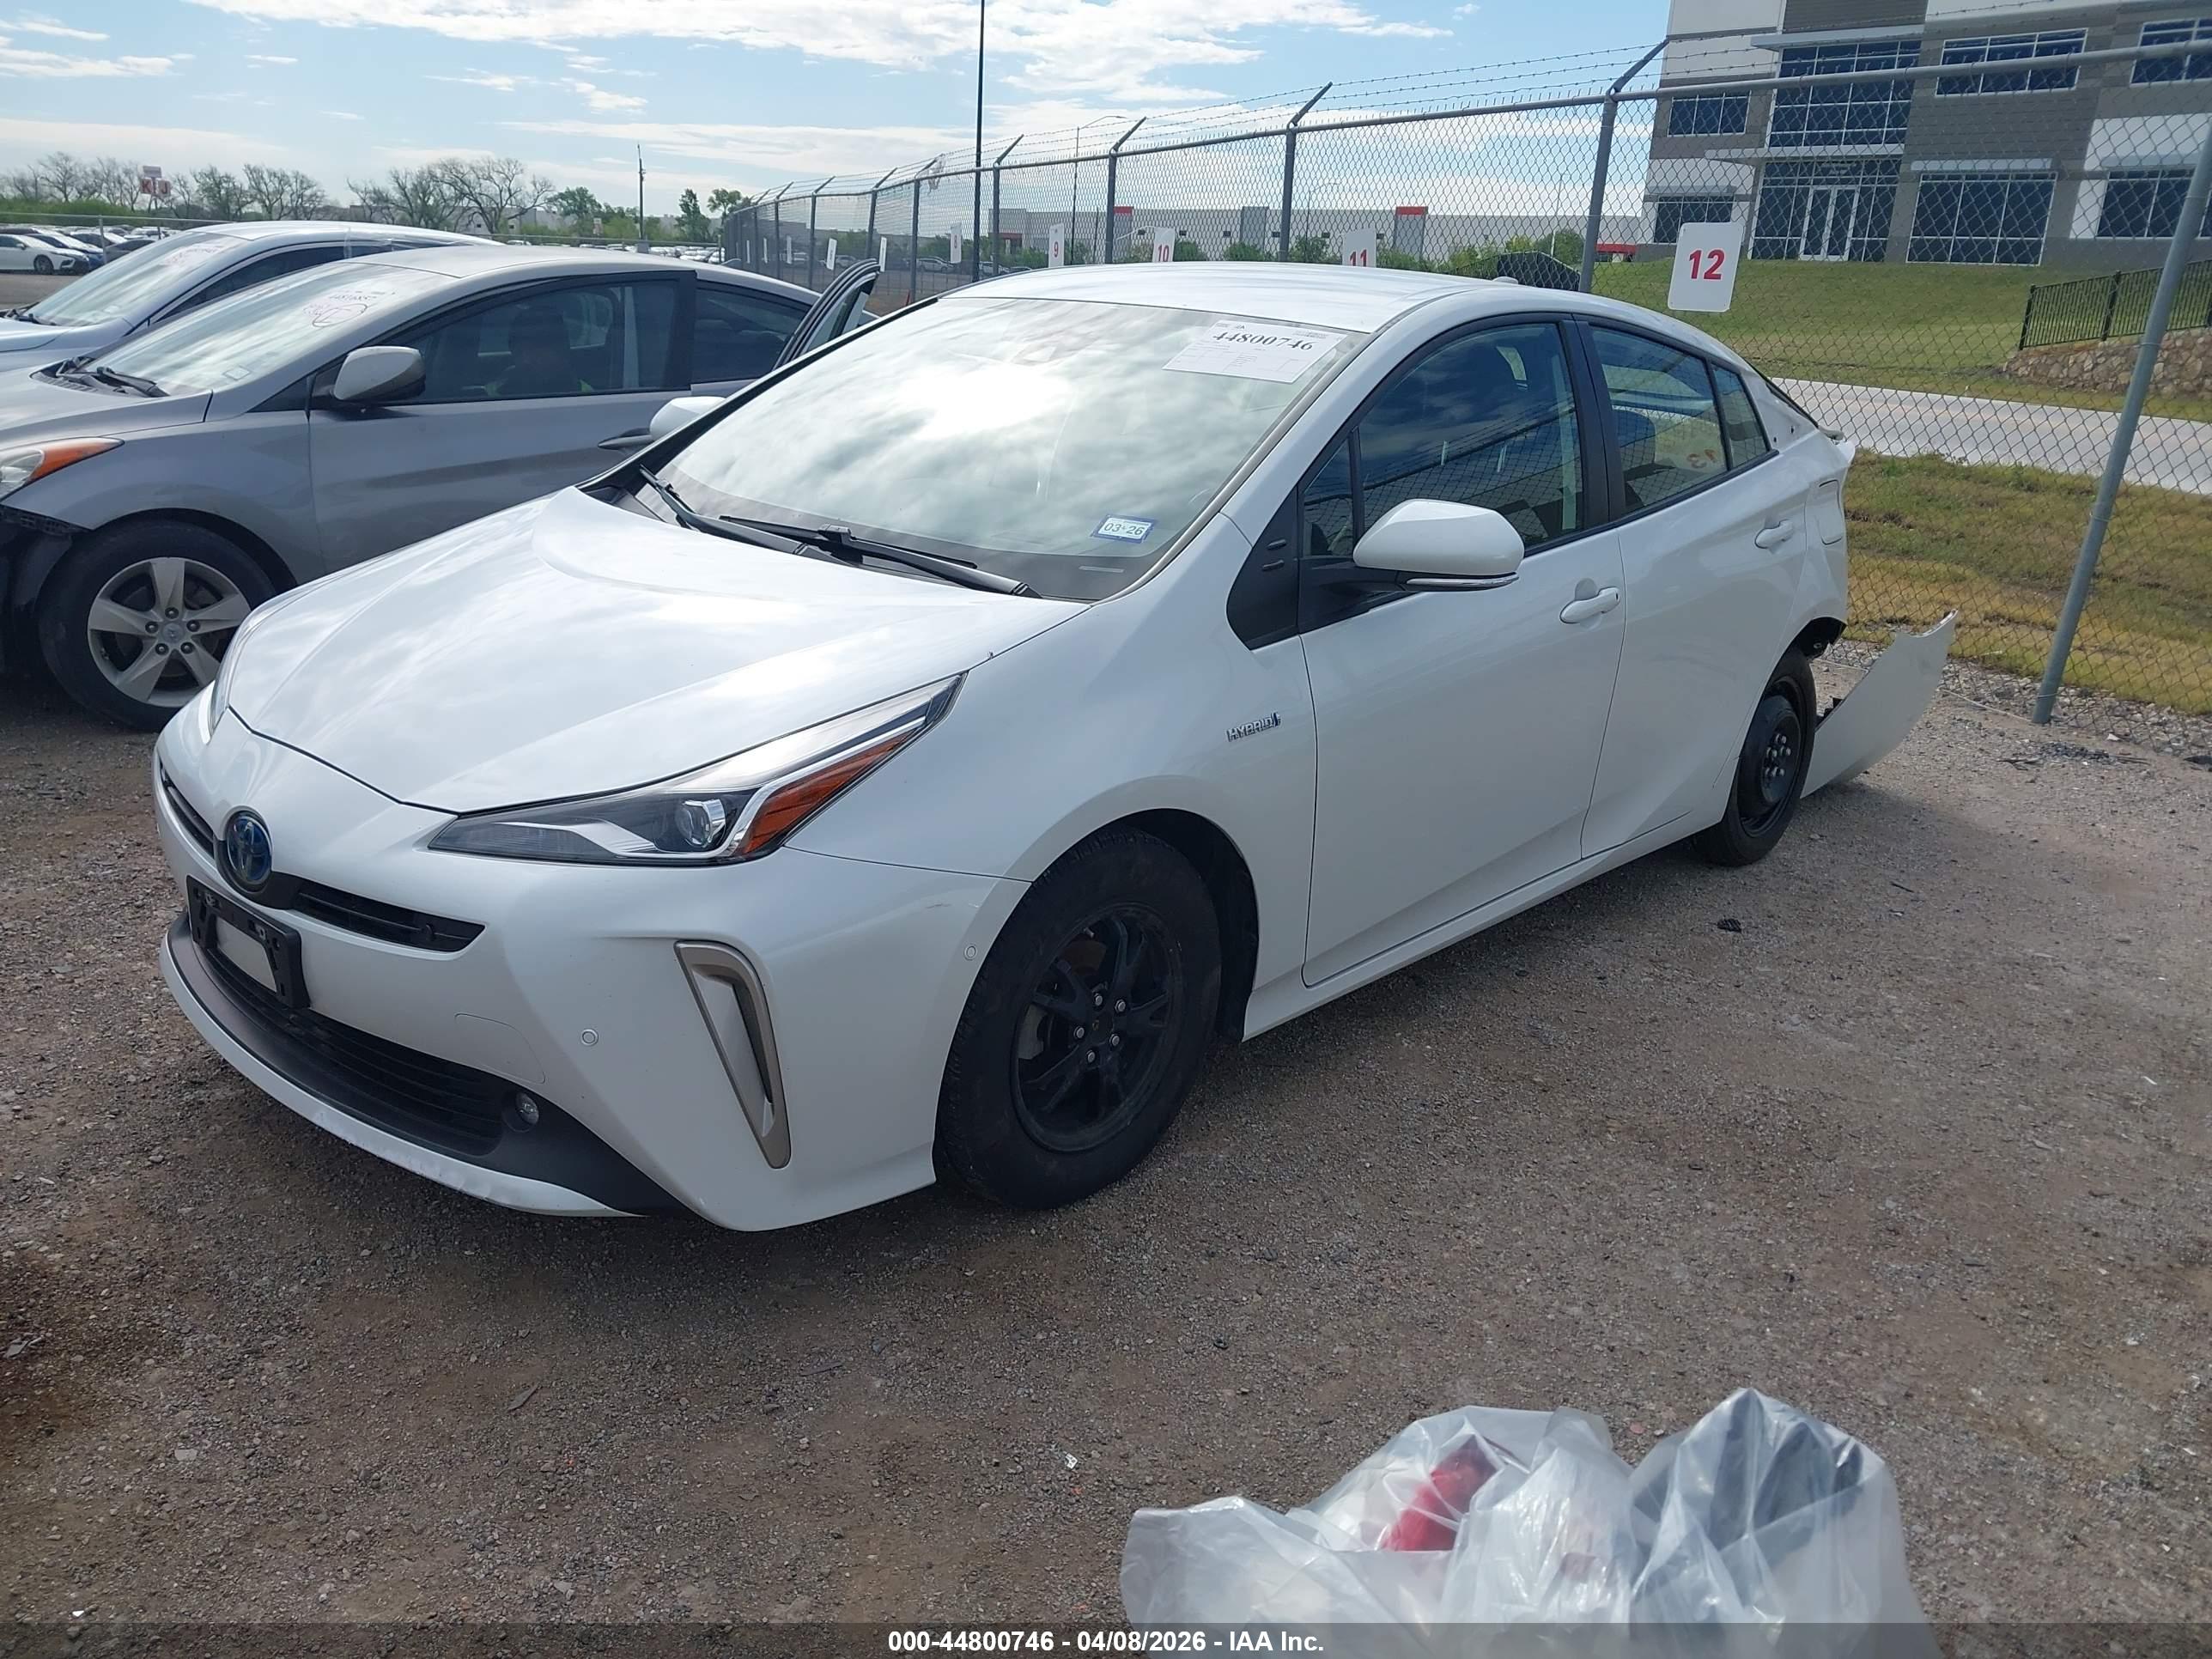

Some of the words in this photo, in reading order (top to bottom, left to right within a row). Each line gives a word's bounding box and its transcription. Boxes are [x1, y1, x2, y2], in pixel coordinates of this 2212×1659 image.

[1054, 241, 1059, 258] 9
[1158, 244, 1170, 262] 10
[1349, 249, 1367, 266] 11
[1689, 249, 1725, 280] 12
[1212, 331, 1314, 350] 44800746
[1104, 523, 1121, 532] 03
[1126, 526, 1145, 535] 26
[1226, 716, 1274, 742] HYBRID
